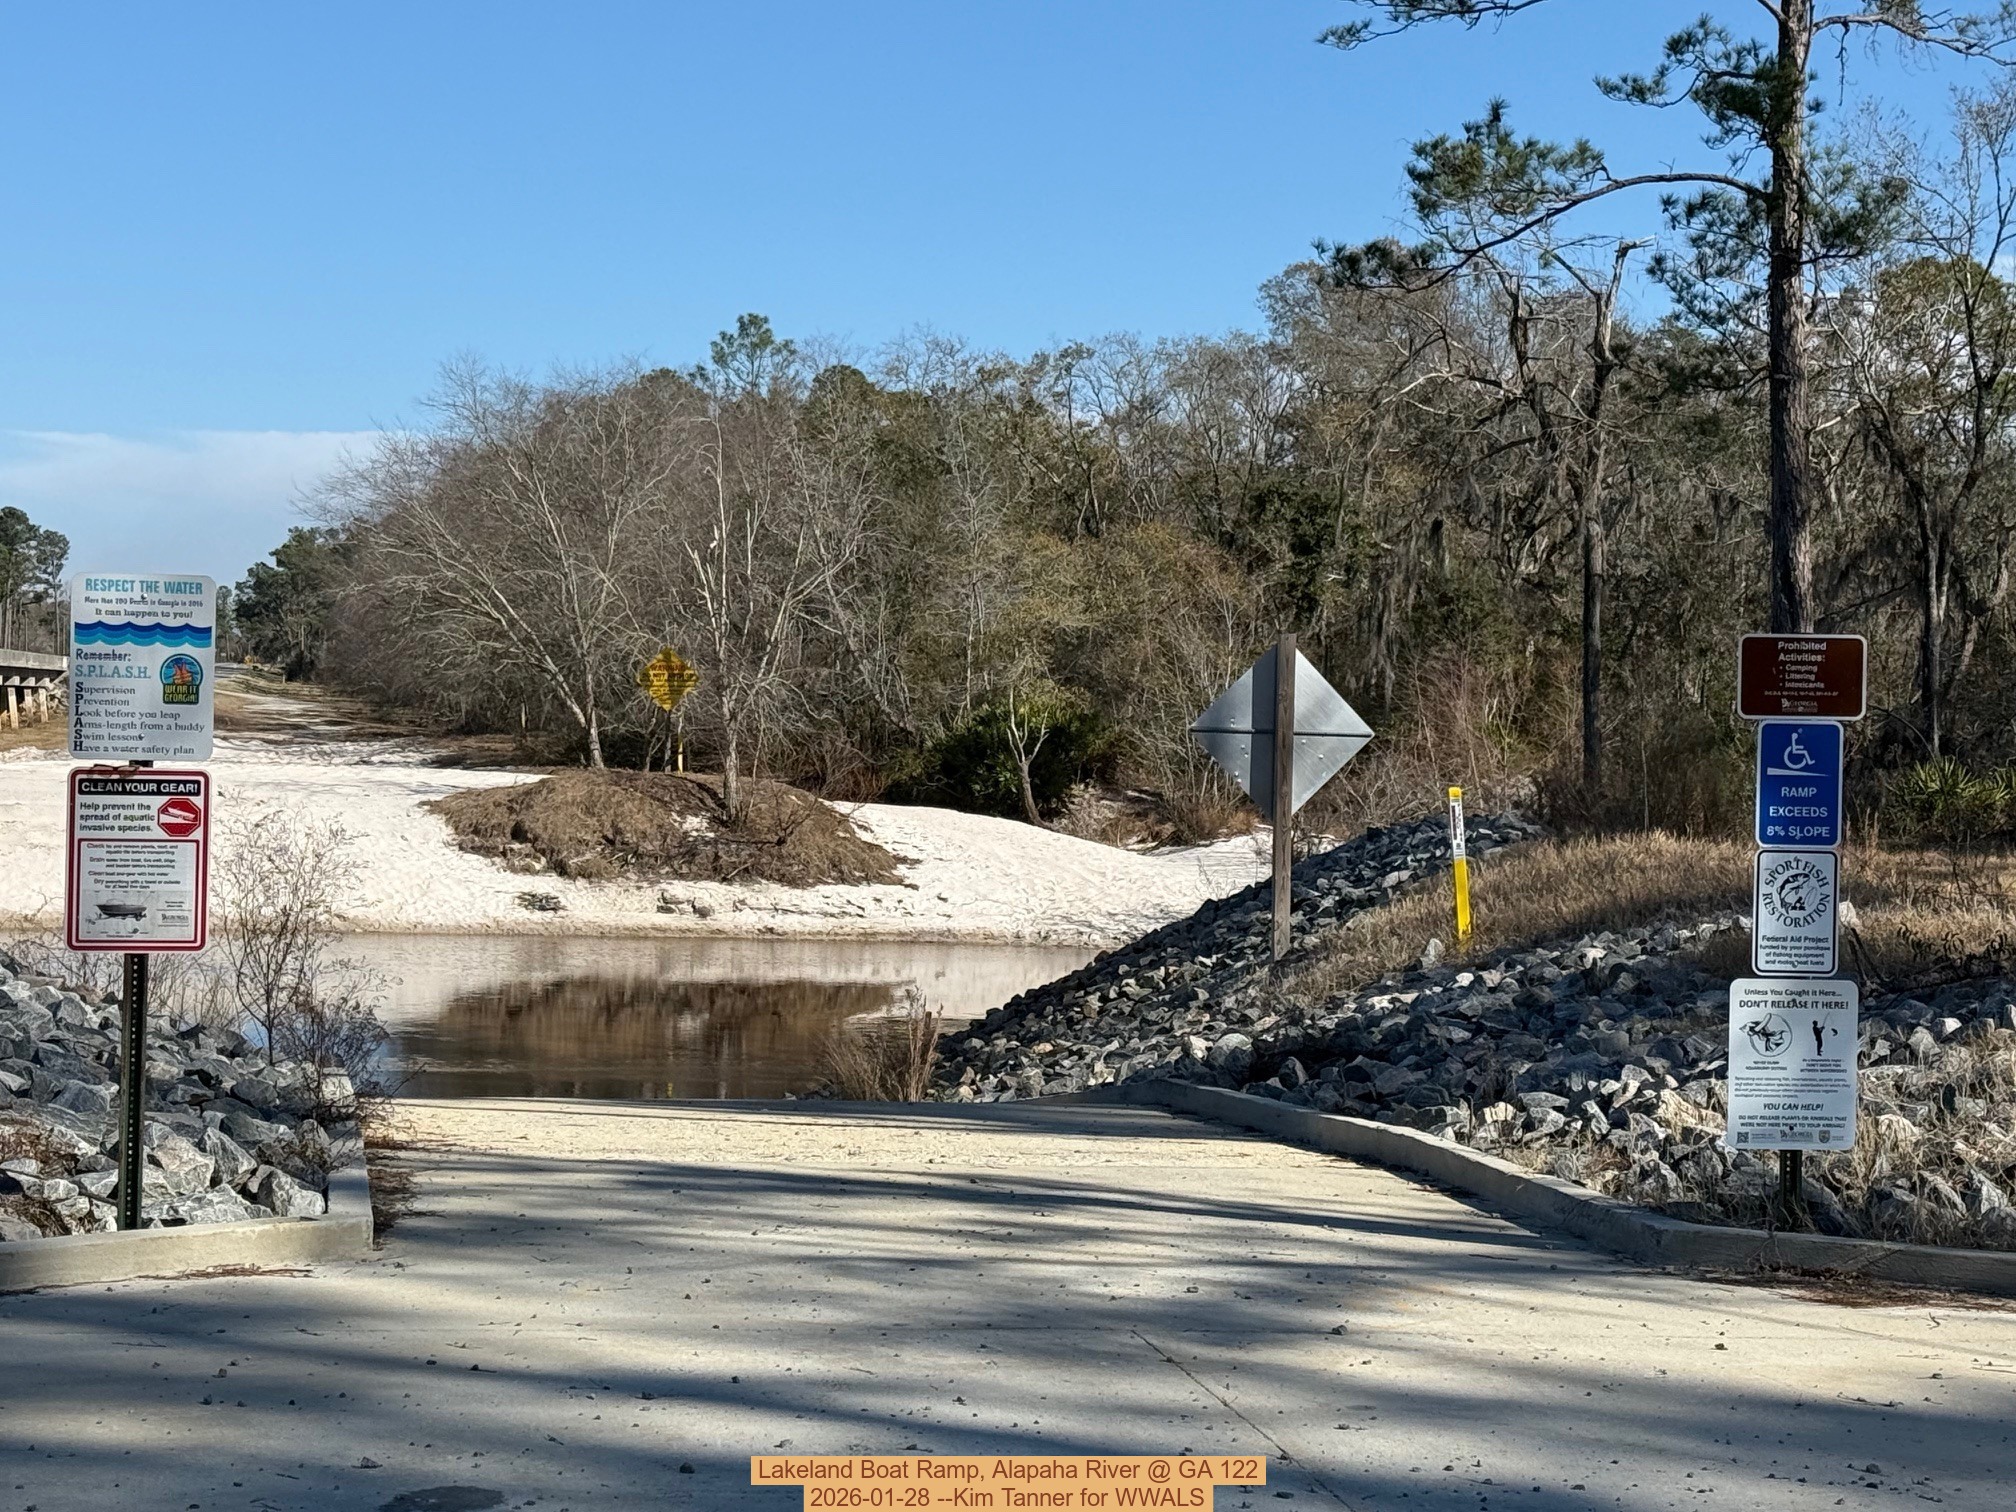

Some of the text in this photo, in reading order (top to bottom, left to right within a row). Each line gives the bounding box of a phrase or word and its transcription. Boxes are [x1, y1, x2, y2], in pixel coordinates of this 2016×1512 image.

[85, 578, 203, 594] RESPECT THE WATER
[95, 608, 102, 616] It
[124, 609, 158, 618] happen
[173, 610, 193, 620] you!
[1778, 642, 1827, 650] Prohibited
[76, 648, 132, 662] Remember:
[1778, 653, 1825, 662] Activities:
[75, 664, 152, 679] S.P.L.A.S.H.
[1785, 664, 1818, 672] Camping
[1785, 673, 1815, 681] Littering
[75, 682, 136, 694] Supervision
[190, 686, 197, 694] IT
[74, 694, 130, 706] Prevention
[74, 706, 181, 721] Look before you leap
[74, 718, 137, 731] Arms-length
[140, 722, 164, 730] from
[174, 722, 205, 733] buddy
[74, 729, 104, 740] Swim
[73, 740, 100, 752] Have
[142, 745, 171, 755] safety
[173, 746, 194, 755] plan
[82, 782, 198, 793] CLEAN YOUR GEAR!
[1781, 787, 1817, 797] RAMP
[80, 802, 100, 811] Help
[102, 803, 135, 811] prevent
[1769, 806, 1828, 817] EXCEEDS
[80, 813, 155, 822] spread of aquatic
[80, 824, 153, 833] invasive species.
[1767, 826, 1830, 837] 8% SLOPE
[1765, 859, 1830, 888] SPORT FISH
[1762, 892, 1830, 928] RESTORATION
[1804, 936, 1829, 944] Project
[1785, 989, 1809, 997] Caught
[1739, 1000, 1848, 1009] DON'T RELEASE IT HERE!
[1801, 1103, 1824, 1111] HELP!
